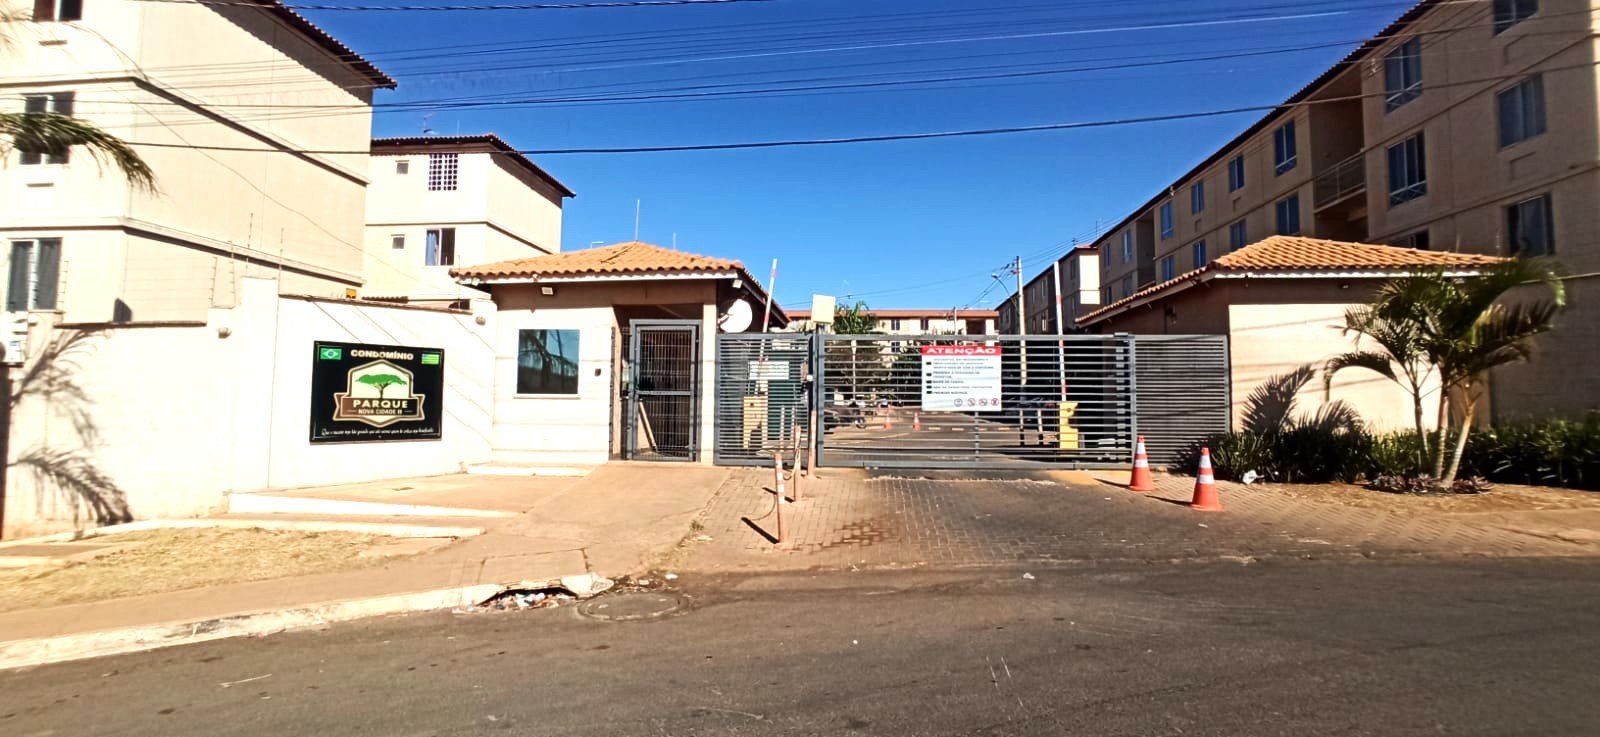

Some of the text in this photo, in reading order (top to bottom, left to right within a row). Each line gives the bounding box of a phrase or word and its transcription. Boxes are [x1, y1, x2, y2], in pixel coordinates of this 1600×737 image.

[351, 350, 414, 360] CONDOMÍNIO
[926, 346, 996, 355] ATENÇÃO
[353, 400, 408, 408] PARQUE
